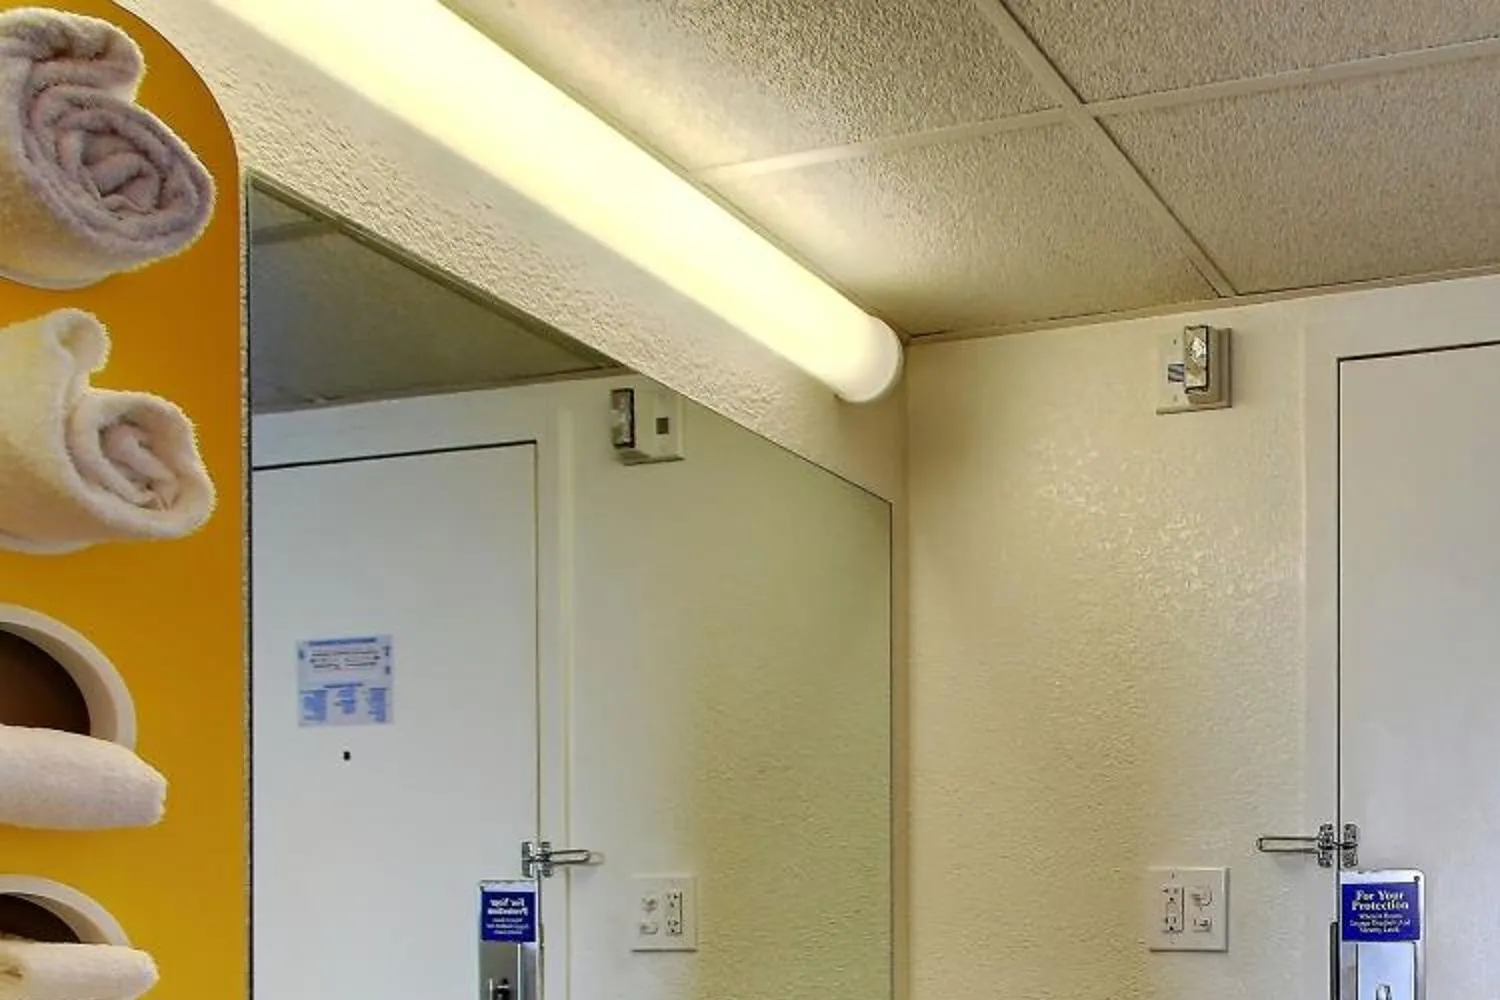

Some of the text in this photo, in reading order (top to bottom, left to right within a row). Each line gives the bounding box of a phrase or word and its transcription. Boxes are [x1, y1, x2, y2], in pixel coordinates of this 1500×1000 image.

[1355, 889, 1404, 901] For Your
[1351, 900, 1409, 911] Protection
